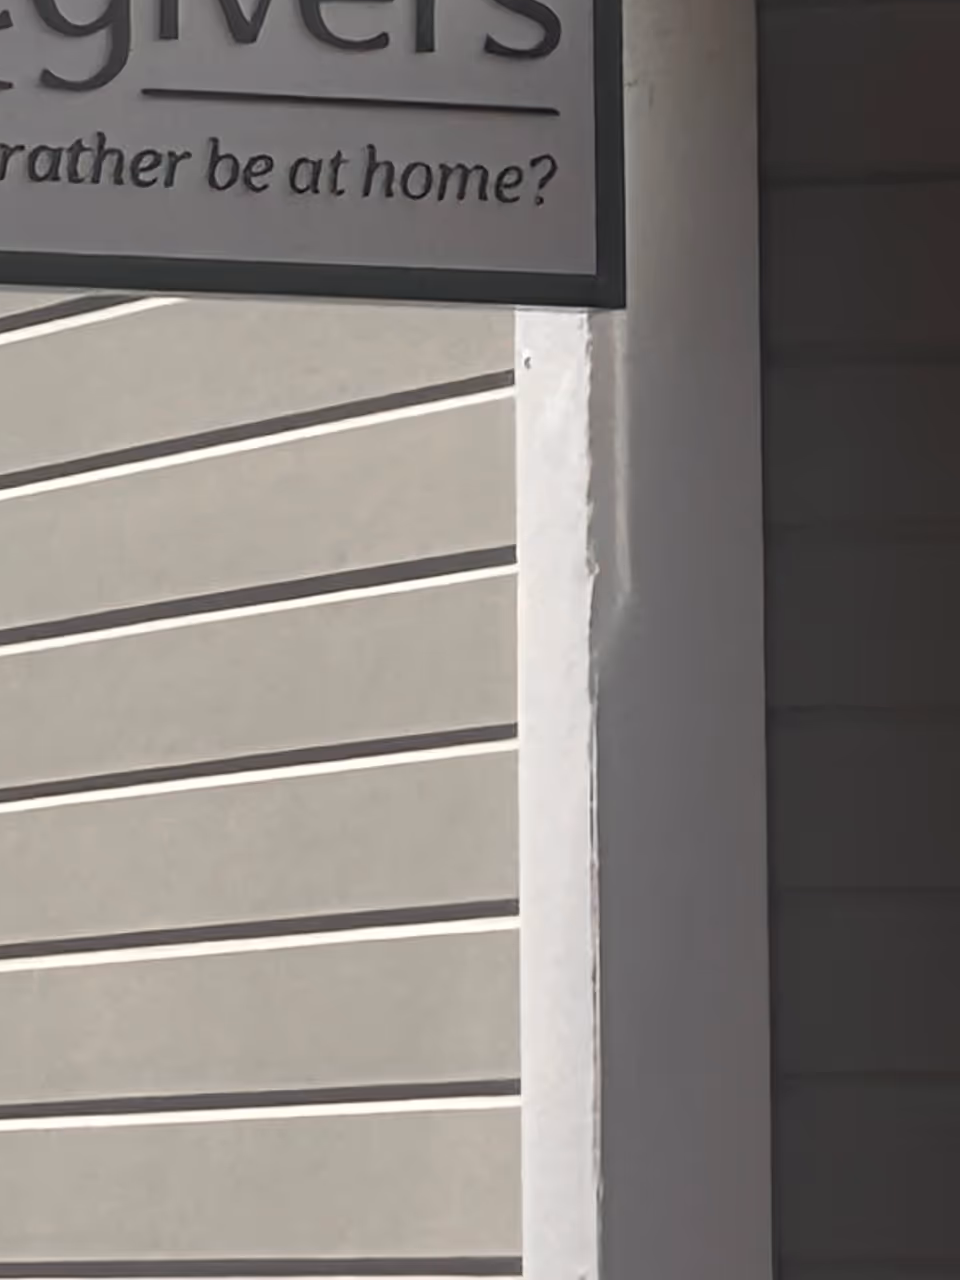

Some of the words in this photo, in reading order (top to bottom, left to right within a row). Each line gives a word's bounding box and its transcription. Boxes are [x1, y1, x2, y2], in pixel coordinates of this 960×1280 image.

[204, 135, 276, 202] be
[287, 148, 351, 198] at
[360, 143, 560, 208] home?
